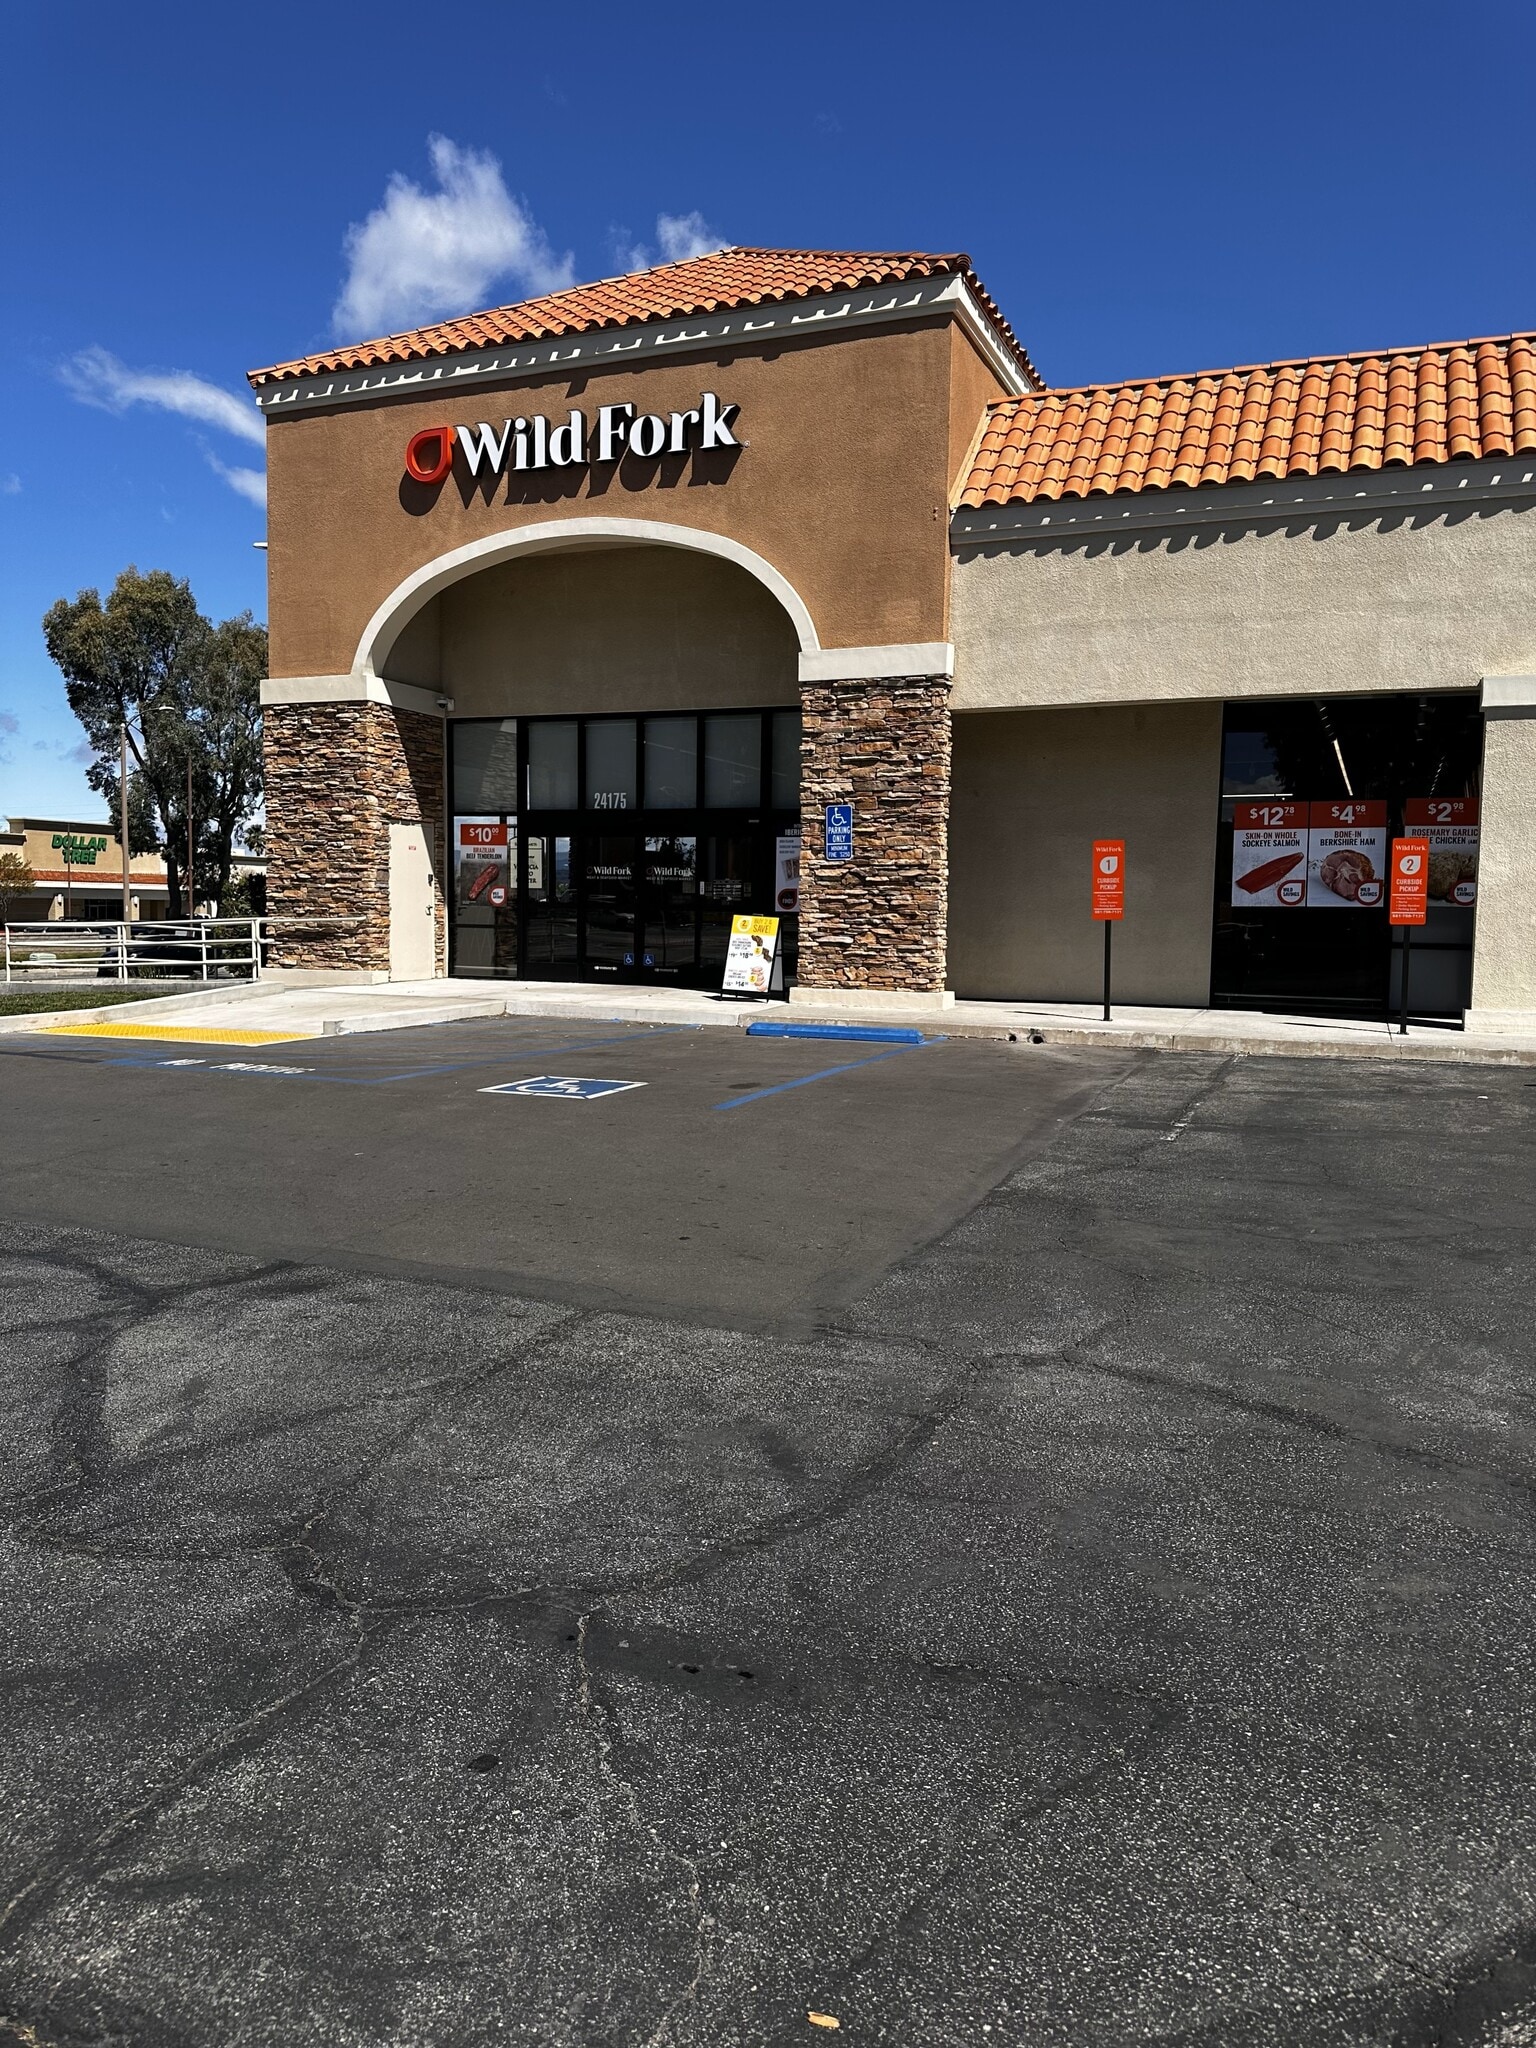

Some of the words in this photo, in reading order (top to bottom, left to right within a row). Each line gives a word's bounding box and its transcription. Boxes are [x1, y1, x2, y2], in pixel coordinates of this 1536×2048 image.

[456, 410, 586, 476] Wild
[596, 392, 740, 461] Fork
[594, 792, 627, 809] 24175
[828, 826, 851, 835] PARKING
[1334, 830, 1362, 838] BONE-IN
[1412, 828, 1450, 837] ROSEMARY
[1452, 828, 1479, 837] GARLIC
[832, 835, 846, 843] ONLY
[1245, 832, 1273, 840] SKIN-ON
[1274, 831, 1298, 839] WHOLE
[52, 834, 107, 851] DOLLAR
[1242, 839, 1272, 848] SOCKEYE
[1272, 839, 1300, 847] SALMON
[1320, 838, 1359, 847] BERKSHIRE
[1359, 838, 1376, 846] HAM
[1436, 836, 1466, 845] CHICKEN
[62, 848, 97, 865] TREE
[1105, 859, 1111, 871] 1
[1406, 858, 1414, 872] 2
[593, 866, 612, 875] Wild
[613, 866, 632, 875] Fork
[653, 866, 673, 876] Wild
[674, 866, 694, 877] Fork
[1396, 878, 1422, 886] CURBSIDE
